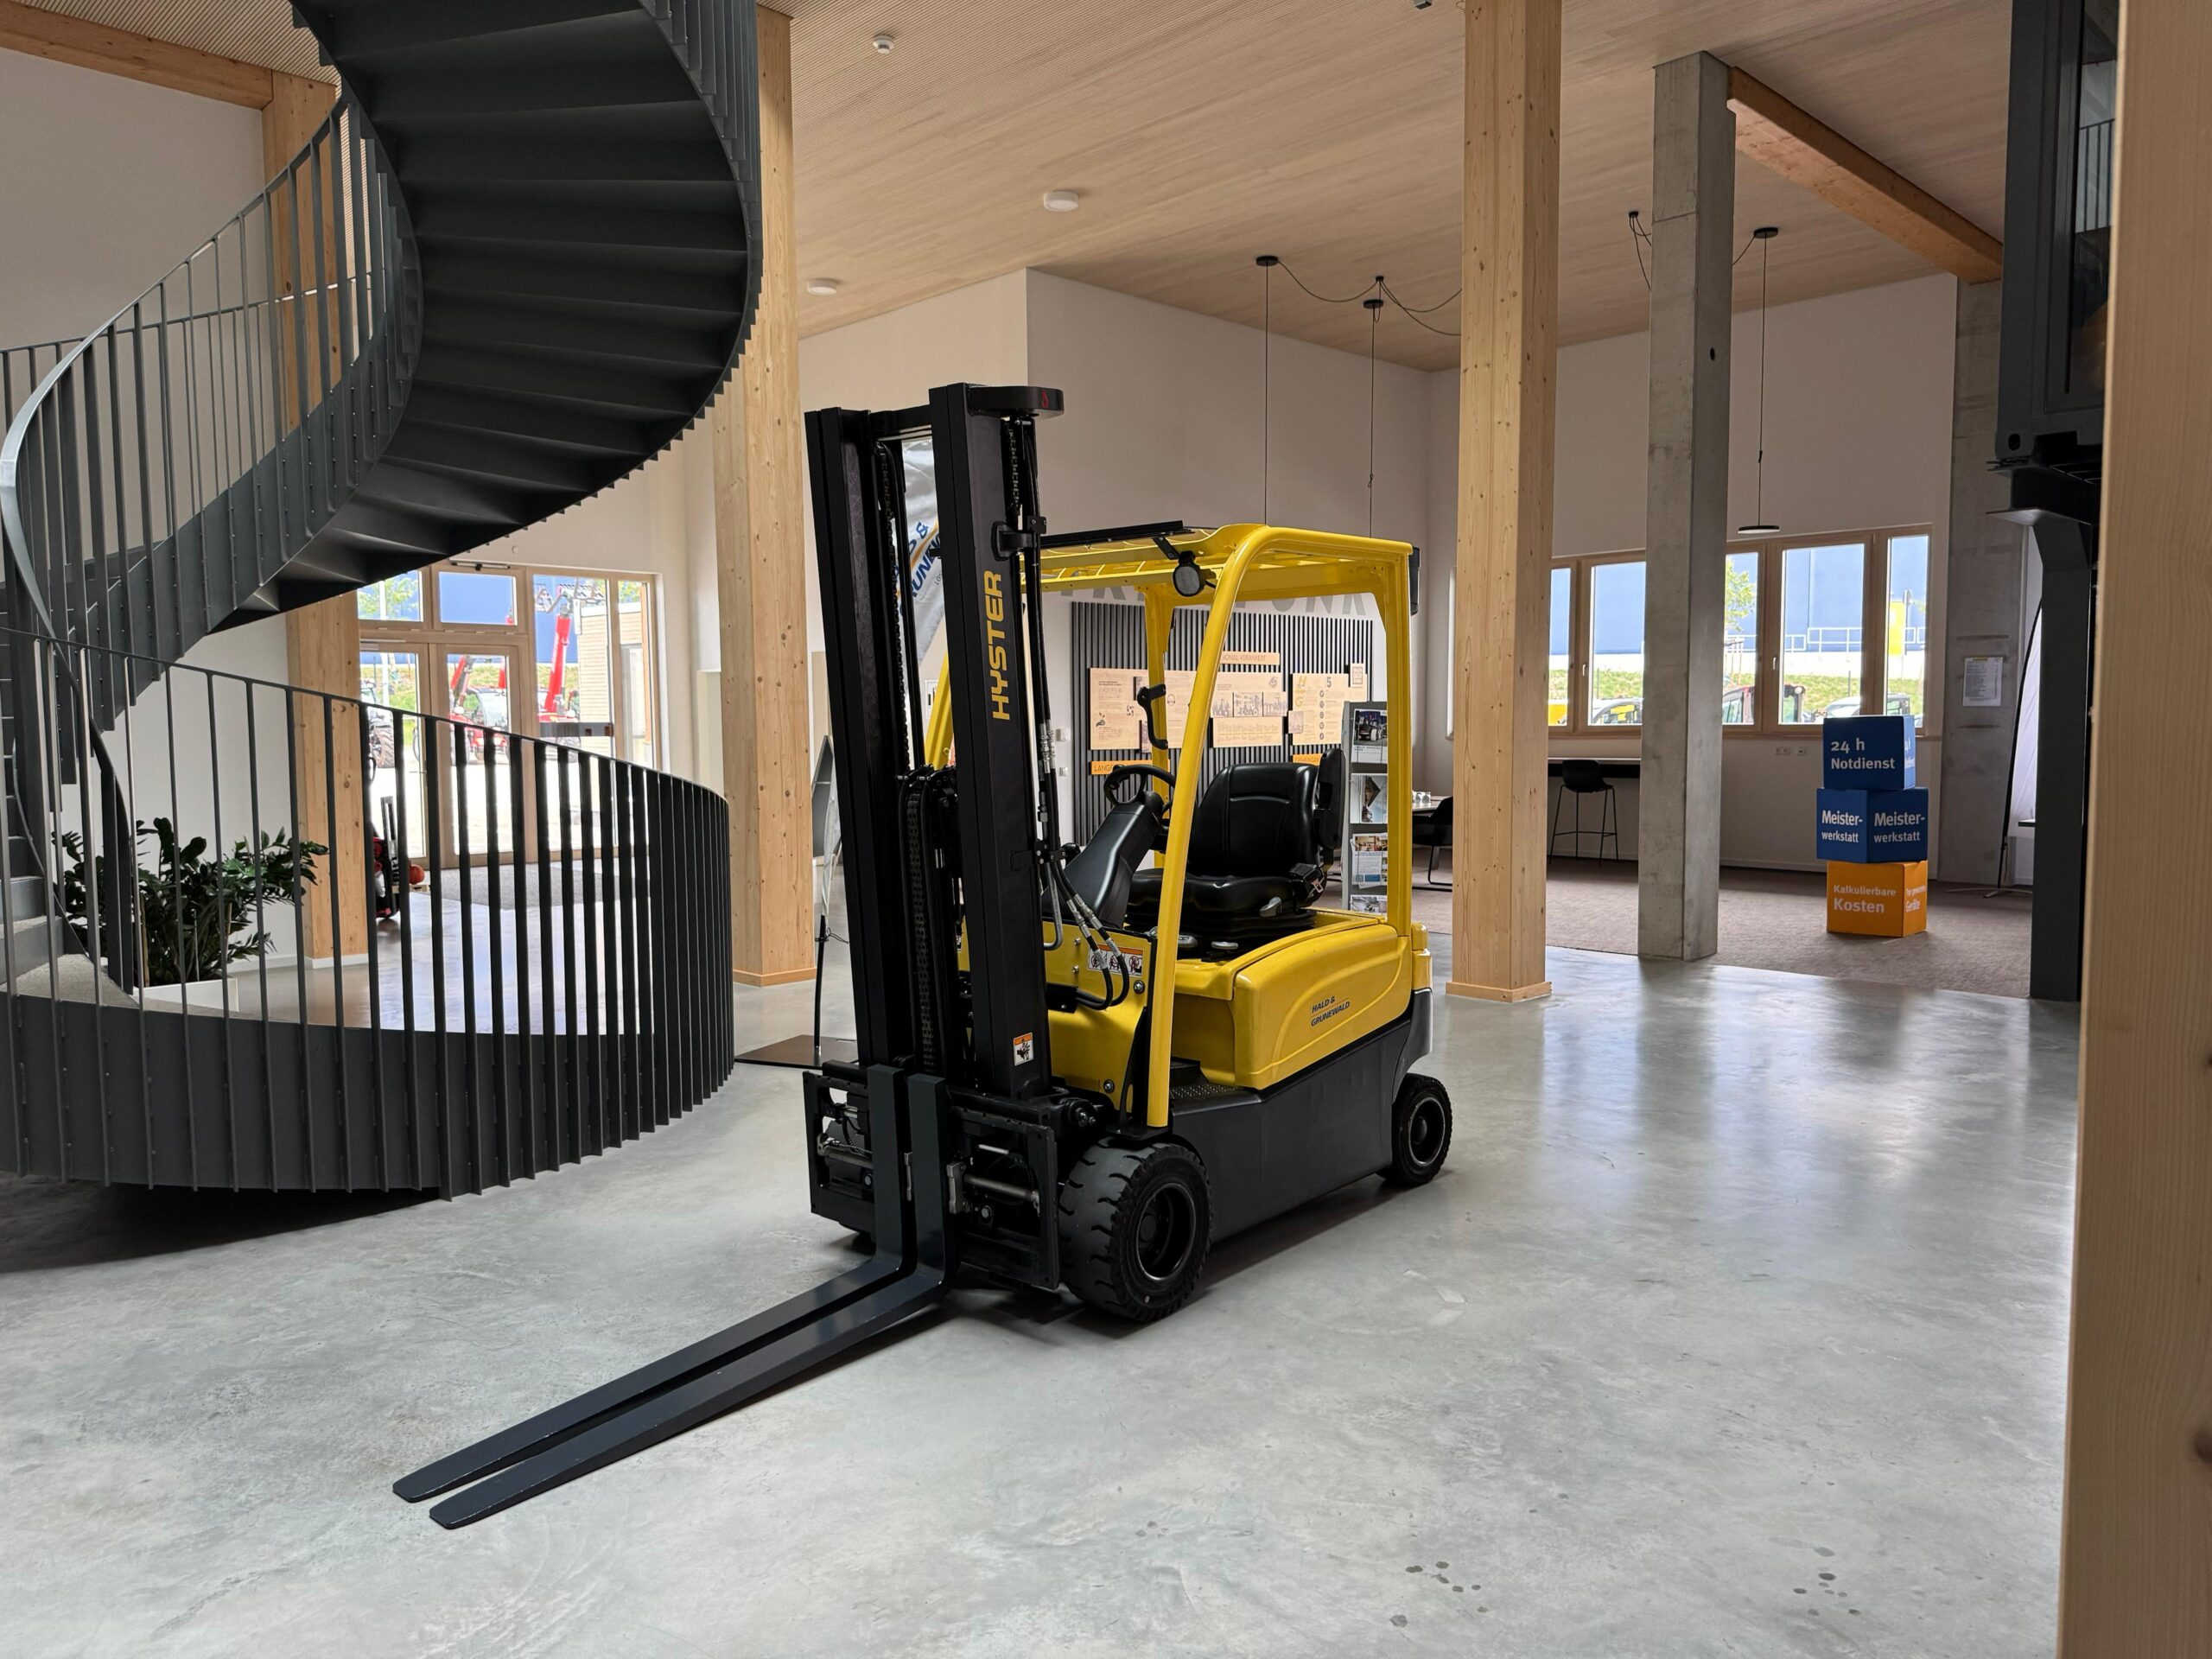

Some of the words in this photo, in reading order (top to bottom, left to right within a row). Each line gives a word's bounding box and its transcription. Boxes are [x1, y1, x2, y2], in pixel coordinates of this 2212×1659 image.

[983, 569, 1010, 721] HYSTER
[1326, 677, 1332, 688] 5
[1830, 741, 1850, 754] 24
[1856, 737, 1866, 752] h
[1830, 757, 1896, 771] Notdienst
[1821, 810, 1863, 826] Meister-
[1873, 811, 1926, 827] Meister-
[1821, 830, 1859, 843] werkstatt
[1873, 830, 1921, 844] werkstatt
[1833, 884, 1897, 897] Kalkulierbare
[1834, 898, 1885, 914] Kosten
[1312, 999, 1330, 1013] HALD
[1311, 1001, 1351, 1027] GRUNEWALD
